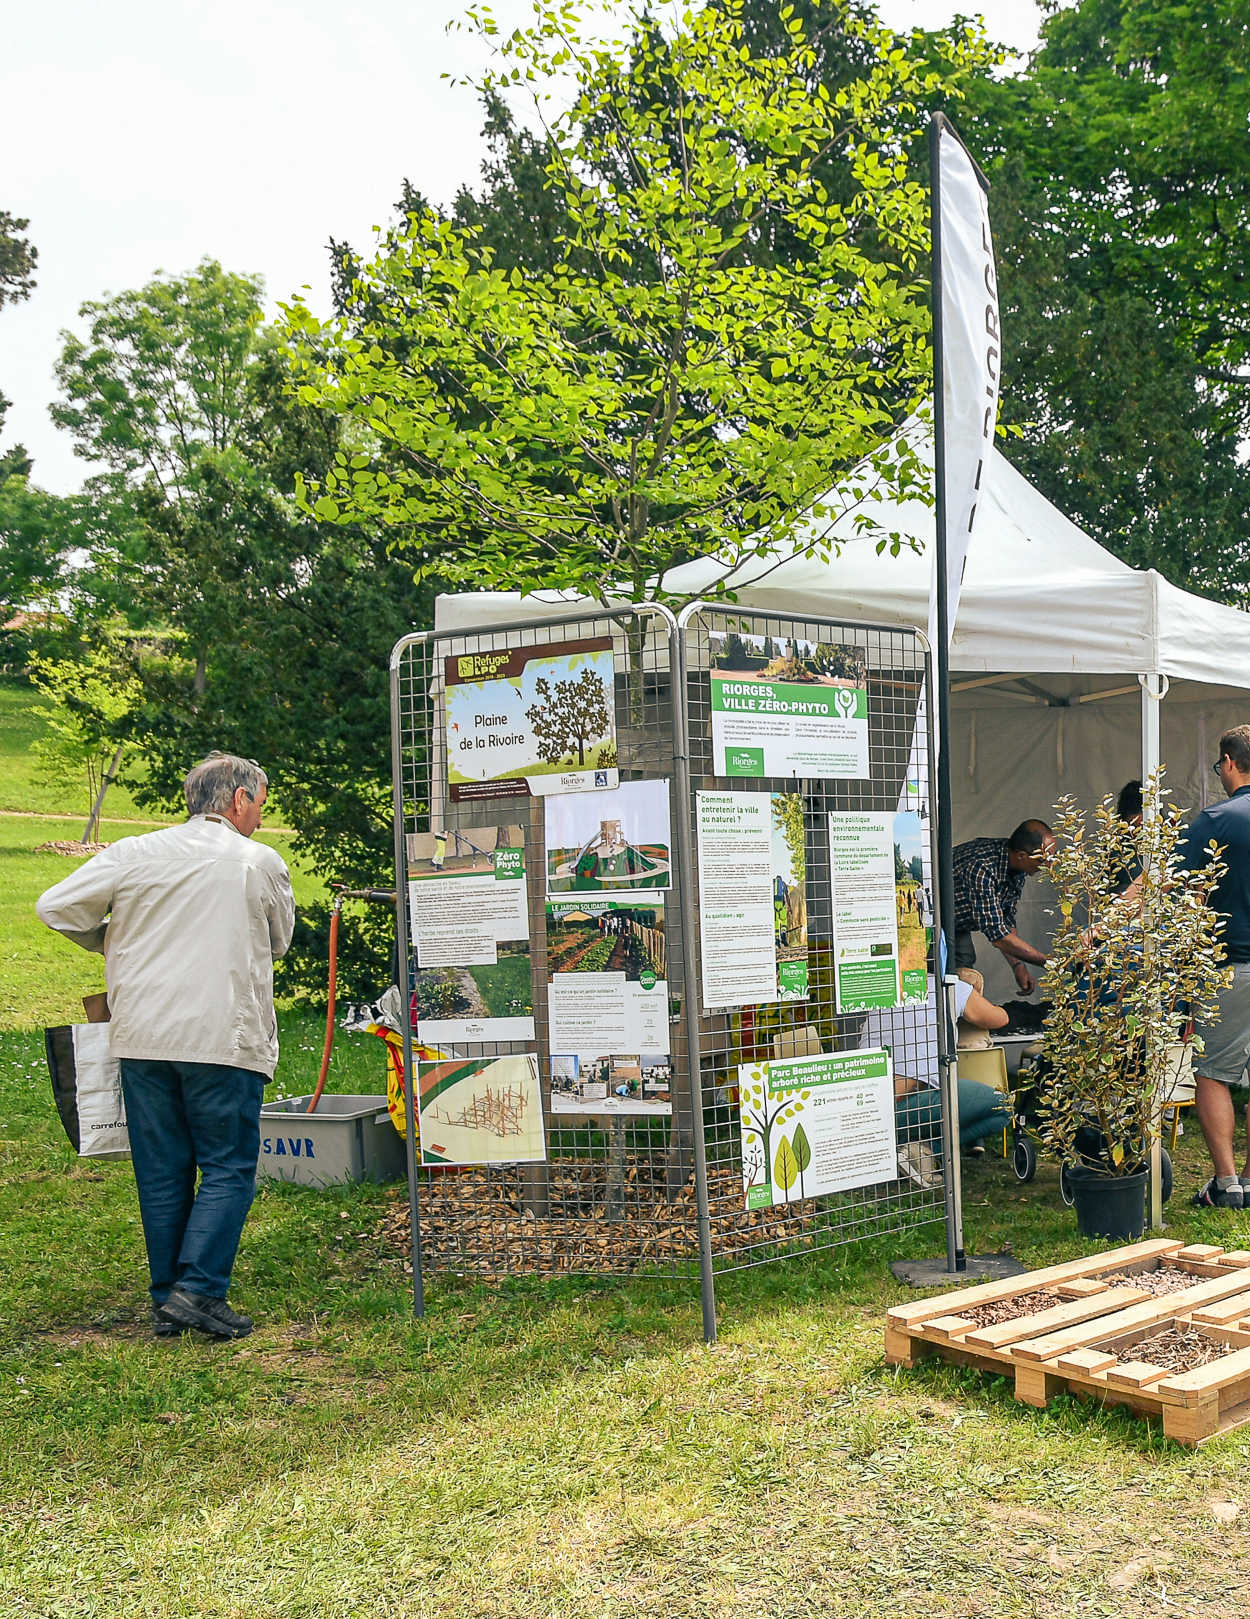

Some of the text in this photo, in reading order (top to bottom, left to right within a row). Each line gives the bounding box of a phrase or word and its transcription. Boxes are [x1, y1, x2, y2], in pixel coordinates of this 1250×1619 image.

[474, 654, 510, 667] Refuges
[474, 665, 497, 675] LPO
[722, 683, 777, 700] RIORGES,
[722, 697, 829, 715] VILLE ZÉRO-PHYTO
[474, 713, 508, 728] Plaine
[459, 732, 525, 751] de la Rivoire
[732, 756, 759, 768] Riorges
[701, 795, 733, 804] Comment
[701, 805, 759, 814] entretenir la ville
[711, 815, 736, 823] naturel
[737, 815, 742, 824] ?
[845, 815, 871, 824] politique
[833, 824, 885, 832] environnementale
[496, 851, 520, 861] Zéro
[496, 860, 521, 870] Phyto
[559, 903, 580, 911] JARDIN
[580, 902, 610, 911] SOLIDAIRE
[782, 967, 804, 976] Riorges
[771, 1068, 791, 1079] Parc
[792, 1063, 828, 1075] Beaulieu
[833, 1061, 844, 1070] un
[844, 1055, 885, 1070] patrimoine
[771, 1067, 867, 1088] arboré riche et précieux
[813, 1097, 826, 1107] 221
[856, 1099, 864, 1107] 69
[90, 1120, 128, 1130] carrefou
